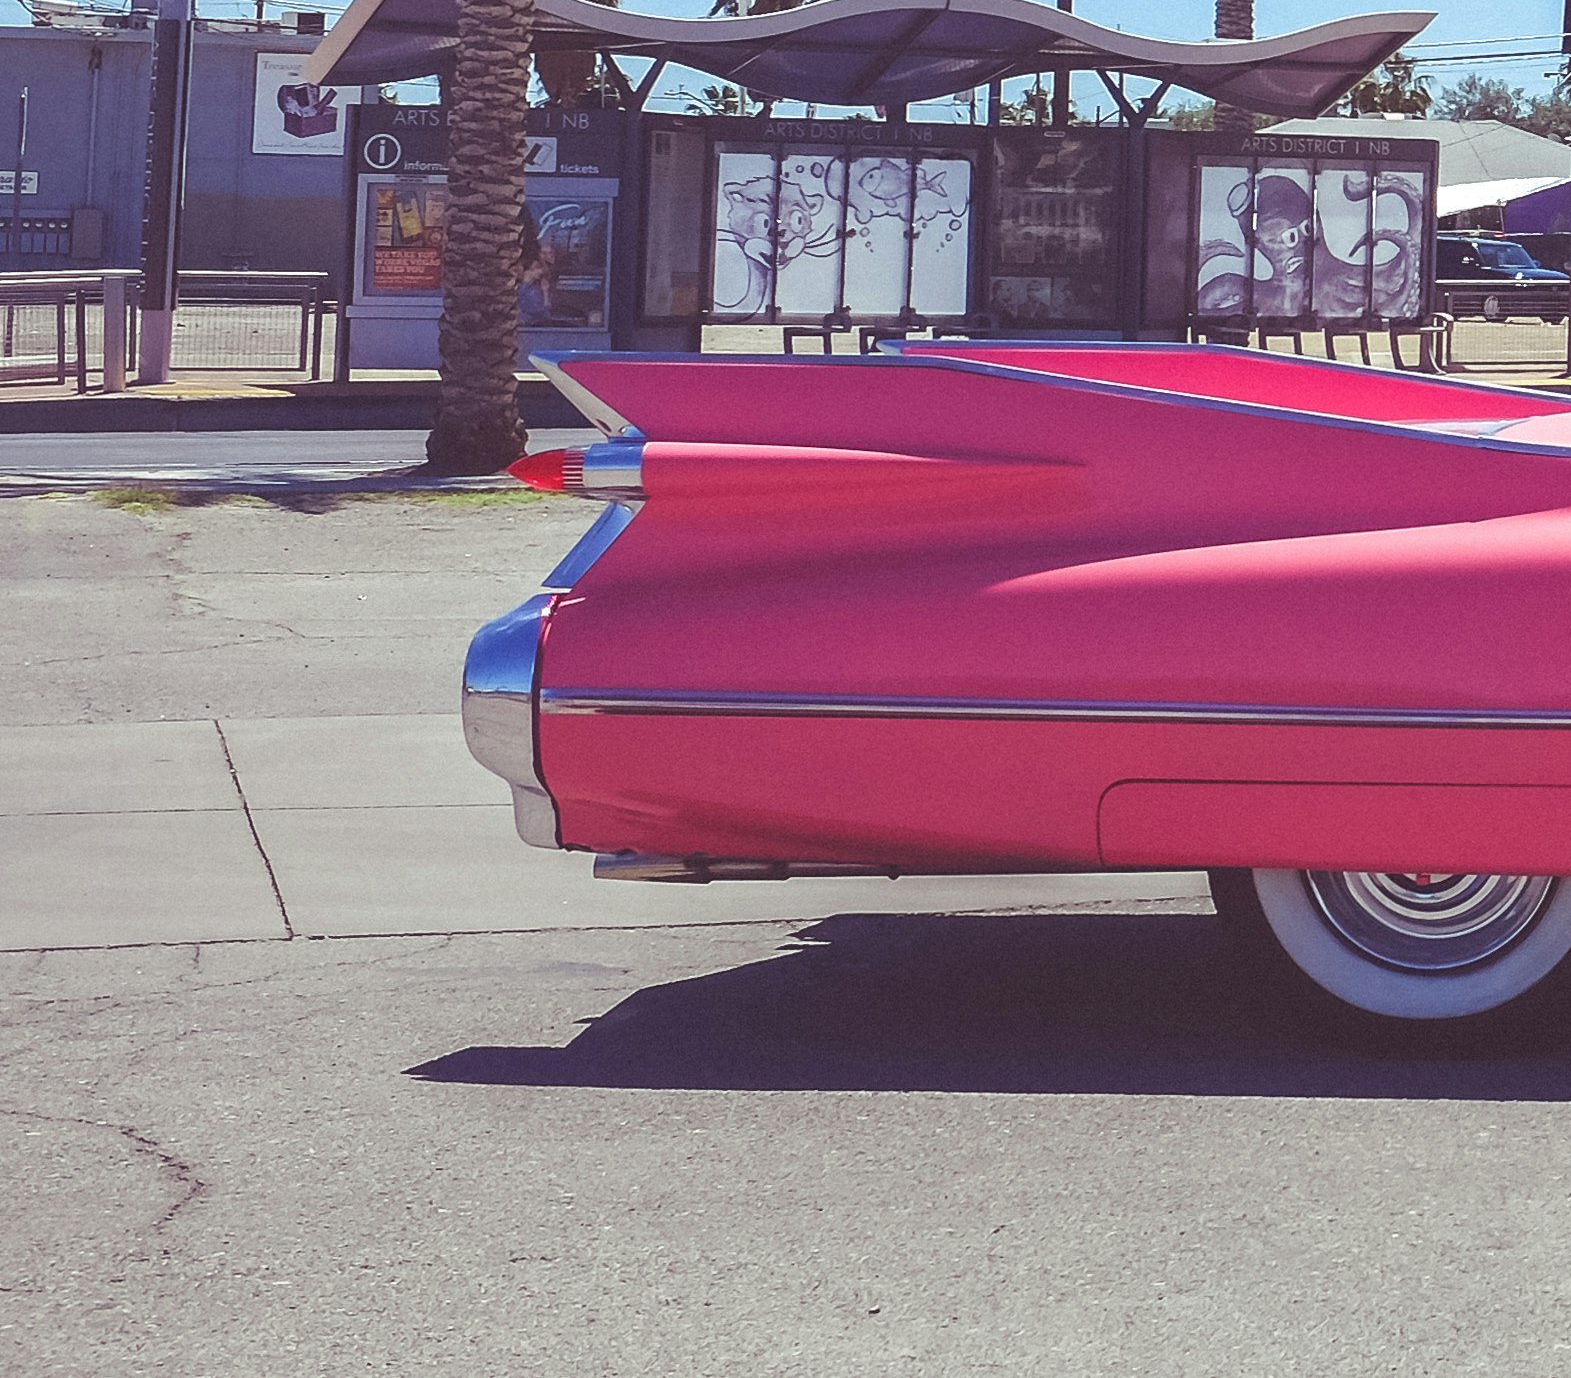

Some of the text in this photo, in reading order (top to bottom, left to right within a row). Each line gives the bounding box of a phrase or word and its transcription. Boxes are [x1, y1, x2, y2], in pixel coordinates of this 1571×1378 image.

[393, 110, 440, 126] ARTS
[562, 113, 589, 130] NB
[765, 123, 805, 138] ARTS
[810, 124, 882, 140] DISTRICT
[909, 128, 933, 142] NB
[1241, 137, 1277, 152] ARTS
[1282, 138, 1346, 154] DISTRICT
[1369, 142, 1390, 156] NB
[560, 164, 600, 174] tickets
